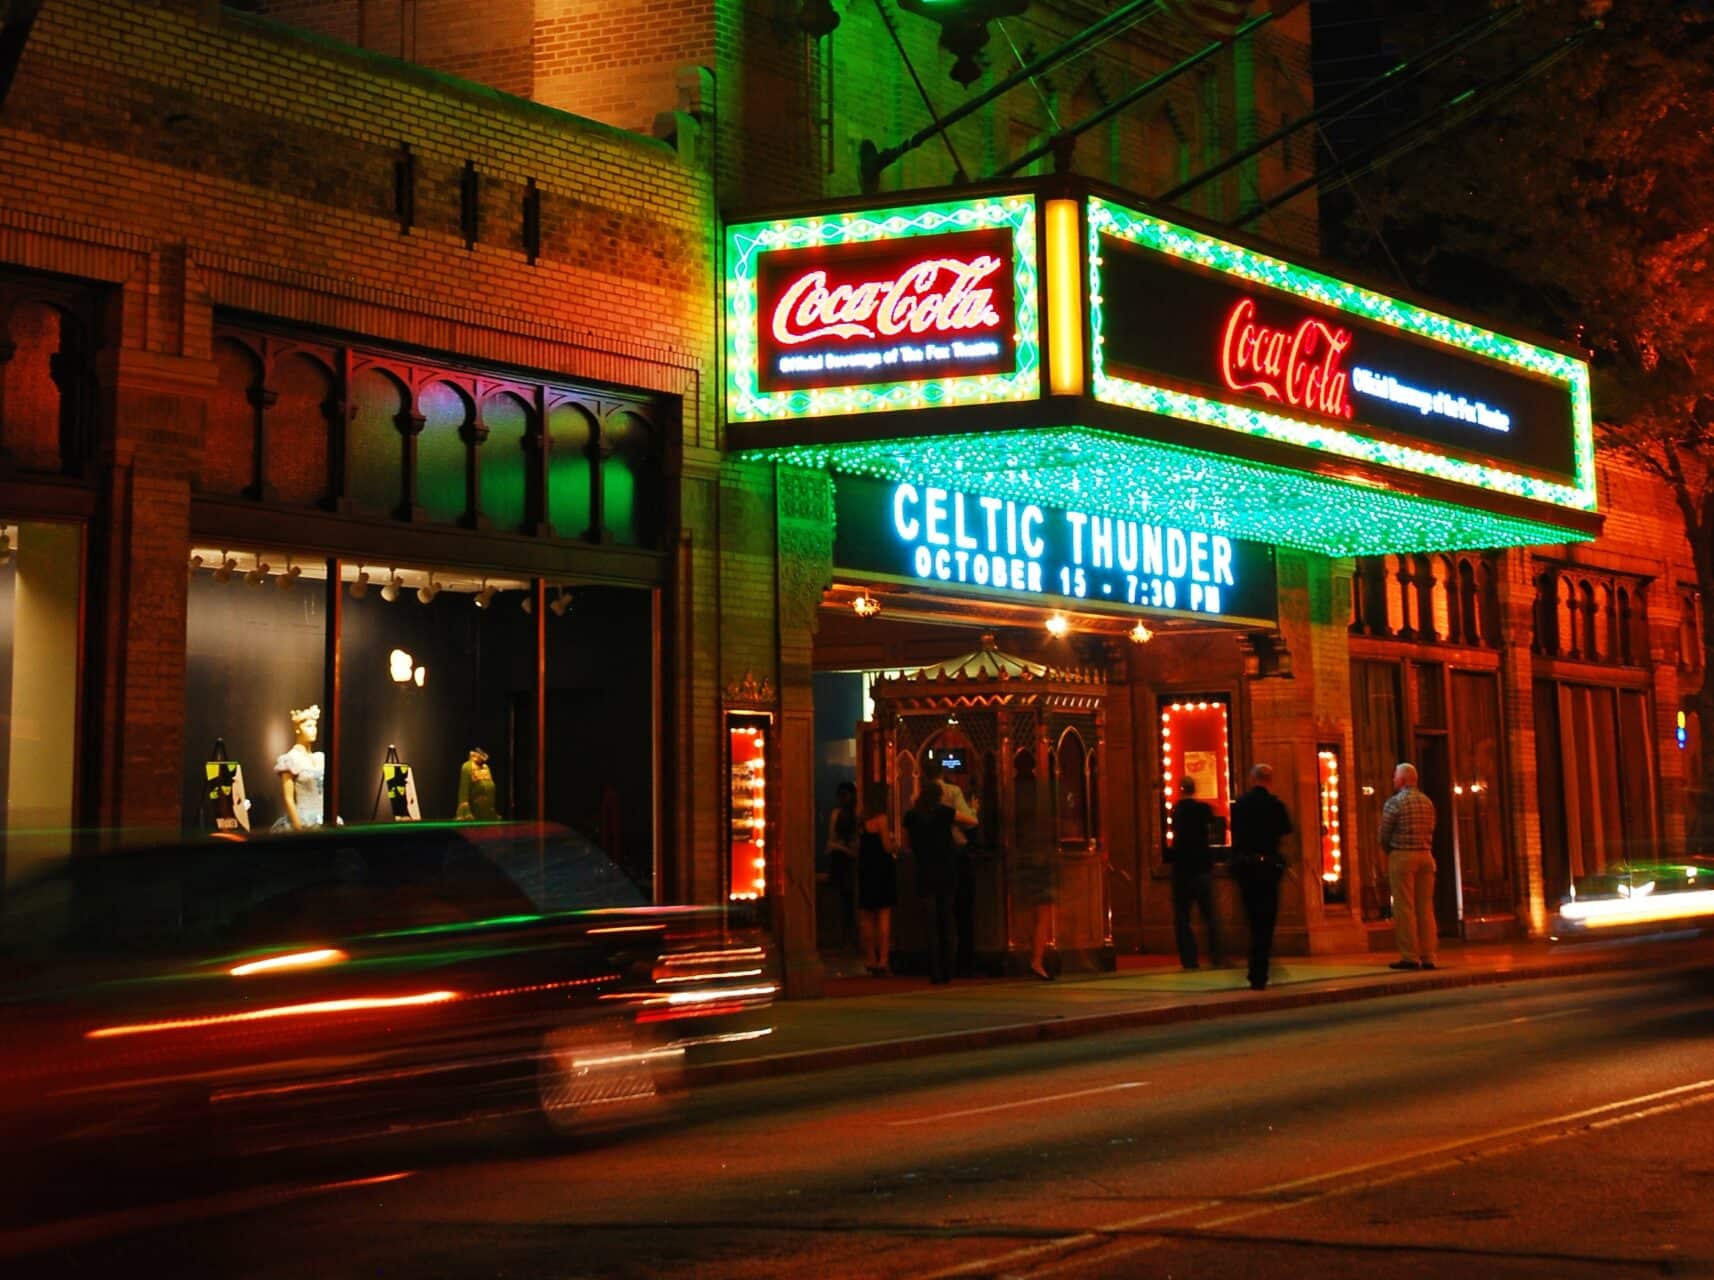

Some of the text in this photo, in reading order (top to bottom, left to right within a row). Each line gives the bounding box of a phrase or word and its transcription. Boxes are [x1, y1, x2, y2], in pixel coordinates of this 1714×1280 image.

[772, 256, 1000, 344] Coca-Cola
[1223, 299, 1352, 418] Coca-Cola
[894, 483, 1234, 586] CELTIC THUNDER
[915, 545, 1042, 592] OCTOBER
[1059, 566, 1087, 598] 15
[1126, 574, 1176, 608] 7:30
[1190, 583, 1220, 613] PM
